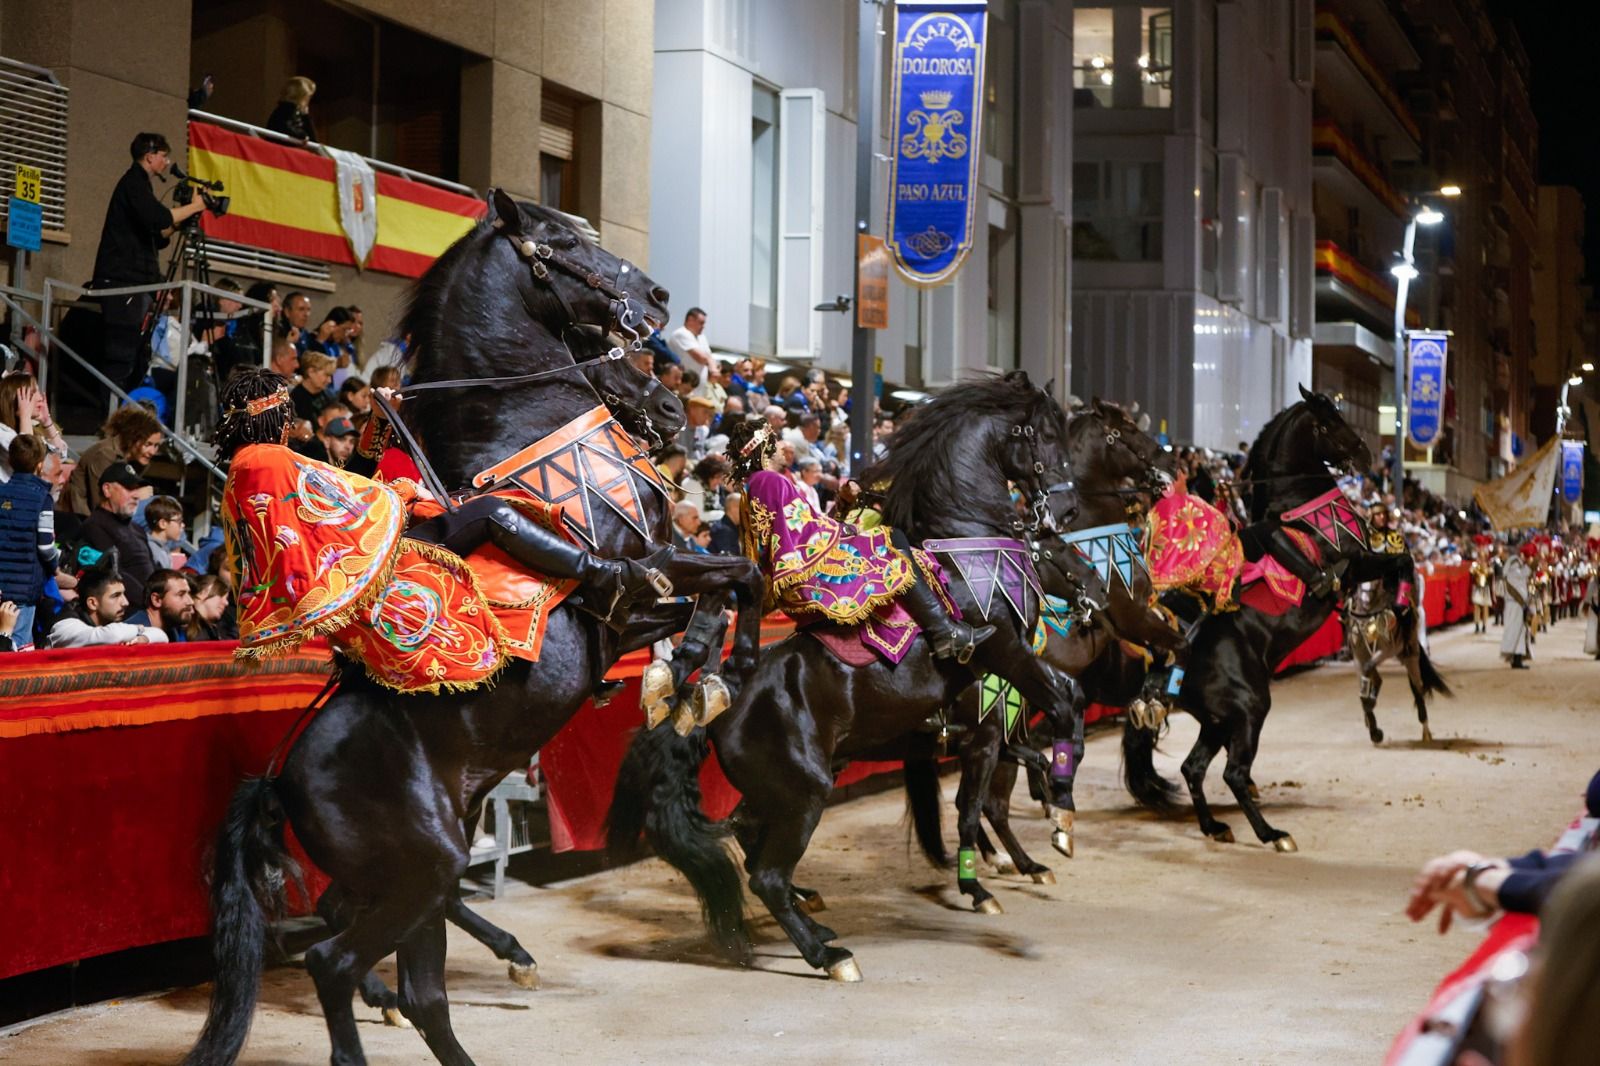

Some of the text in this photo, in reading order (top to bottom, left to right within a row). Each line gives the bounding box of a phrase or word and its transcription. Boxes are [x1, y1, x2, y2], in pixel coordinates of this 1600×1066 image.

[910, 22, 969, 52] MATER
[902, 57, 974, 76] DOLOROSA
[17, 165, 40, 181] Pasillo
[21, 181, 36, 200] 35
[897, 183, 966, 201] PASO AZUL
